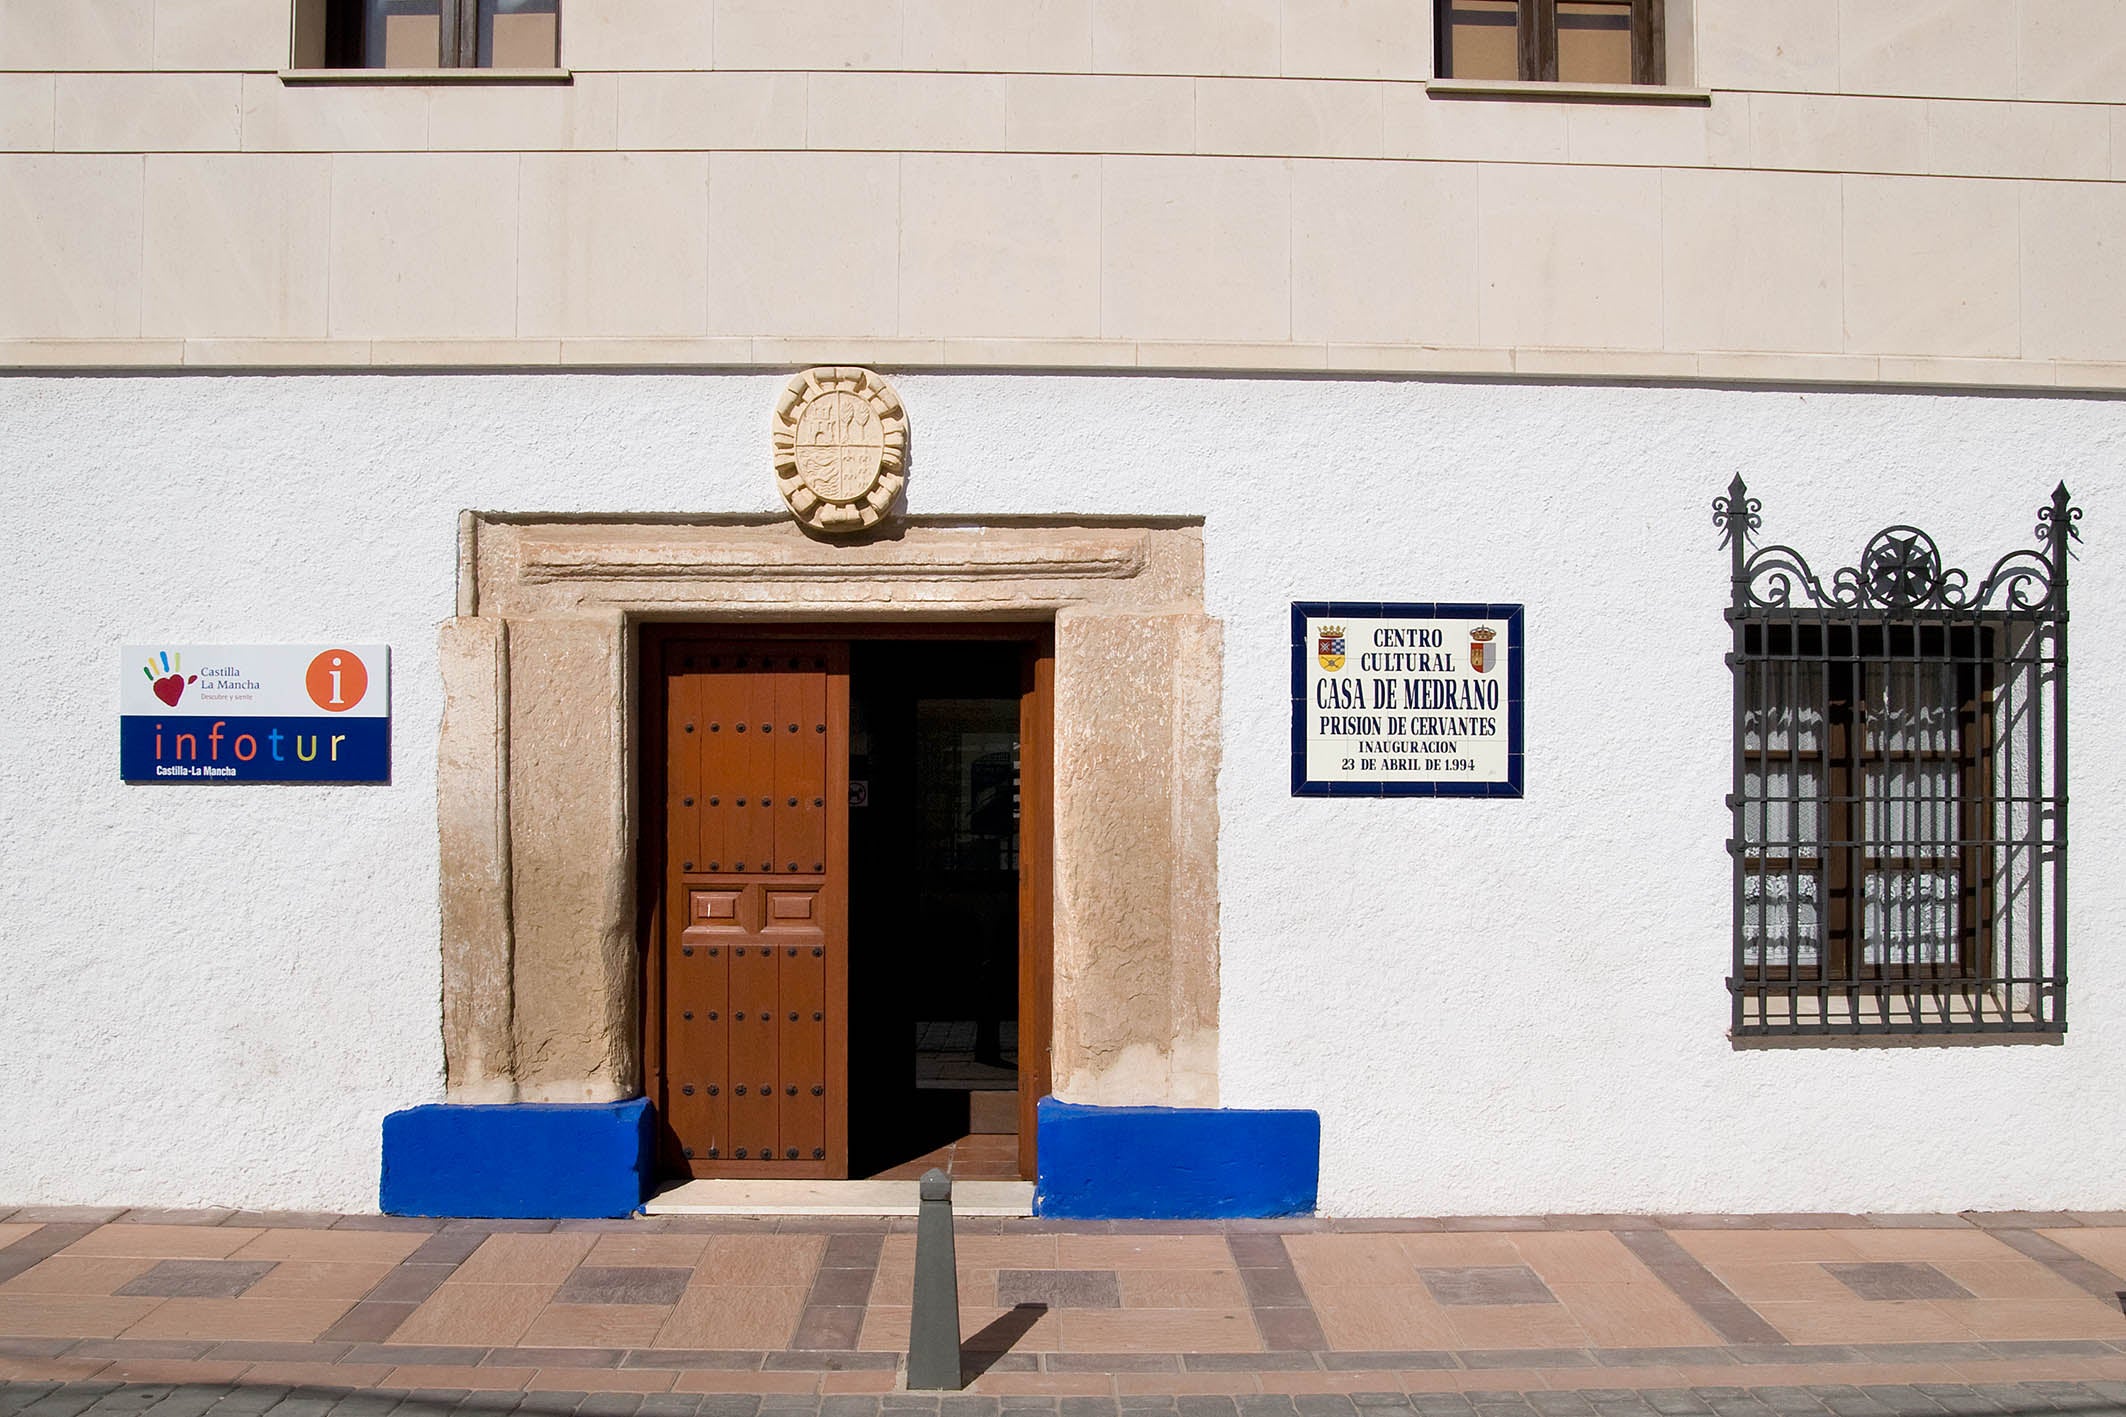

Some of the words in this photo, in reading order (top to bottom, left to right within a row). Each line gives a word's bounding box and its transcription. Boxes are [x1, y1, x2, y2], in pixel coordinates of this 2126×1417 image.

[1373, 628, 1443, 648] CENTRO
[200, 666, 241, 677] Castilla
[1361, 652, 1456, 672] CULTURAL
[201, 679, 214, 690] La
[217, 679, 261, 690] Mancha
[329, 657, 345, 704] i
[1316, 678, 1366, 710] CASA
[1373, 678, 1397, 710] DE
[1404, 678, 1499, 711] MEDRANO
[1320, 716, 1382, 735] PRISION
[1388, 716, 1407, 735] DE
[1410, 716, 1496, 736] CERVANTES
[155, 721, 346, 762] infotur
[1359, 741, 1457, 754] INAUGURACION
[156, 765, 202, 776] Castilla-La
[203, 766, 236, 776] Mancha
[1341, 758, 1355, 771] 23
[1361, 758, 1377, 771] DE
[1381, 759, 1421, 771] ABRIL
[1425, 759, 1441, 771] DE
[1445, 759, 1476, 771] 1.994
